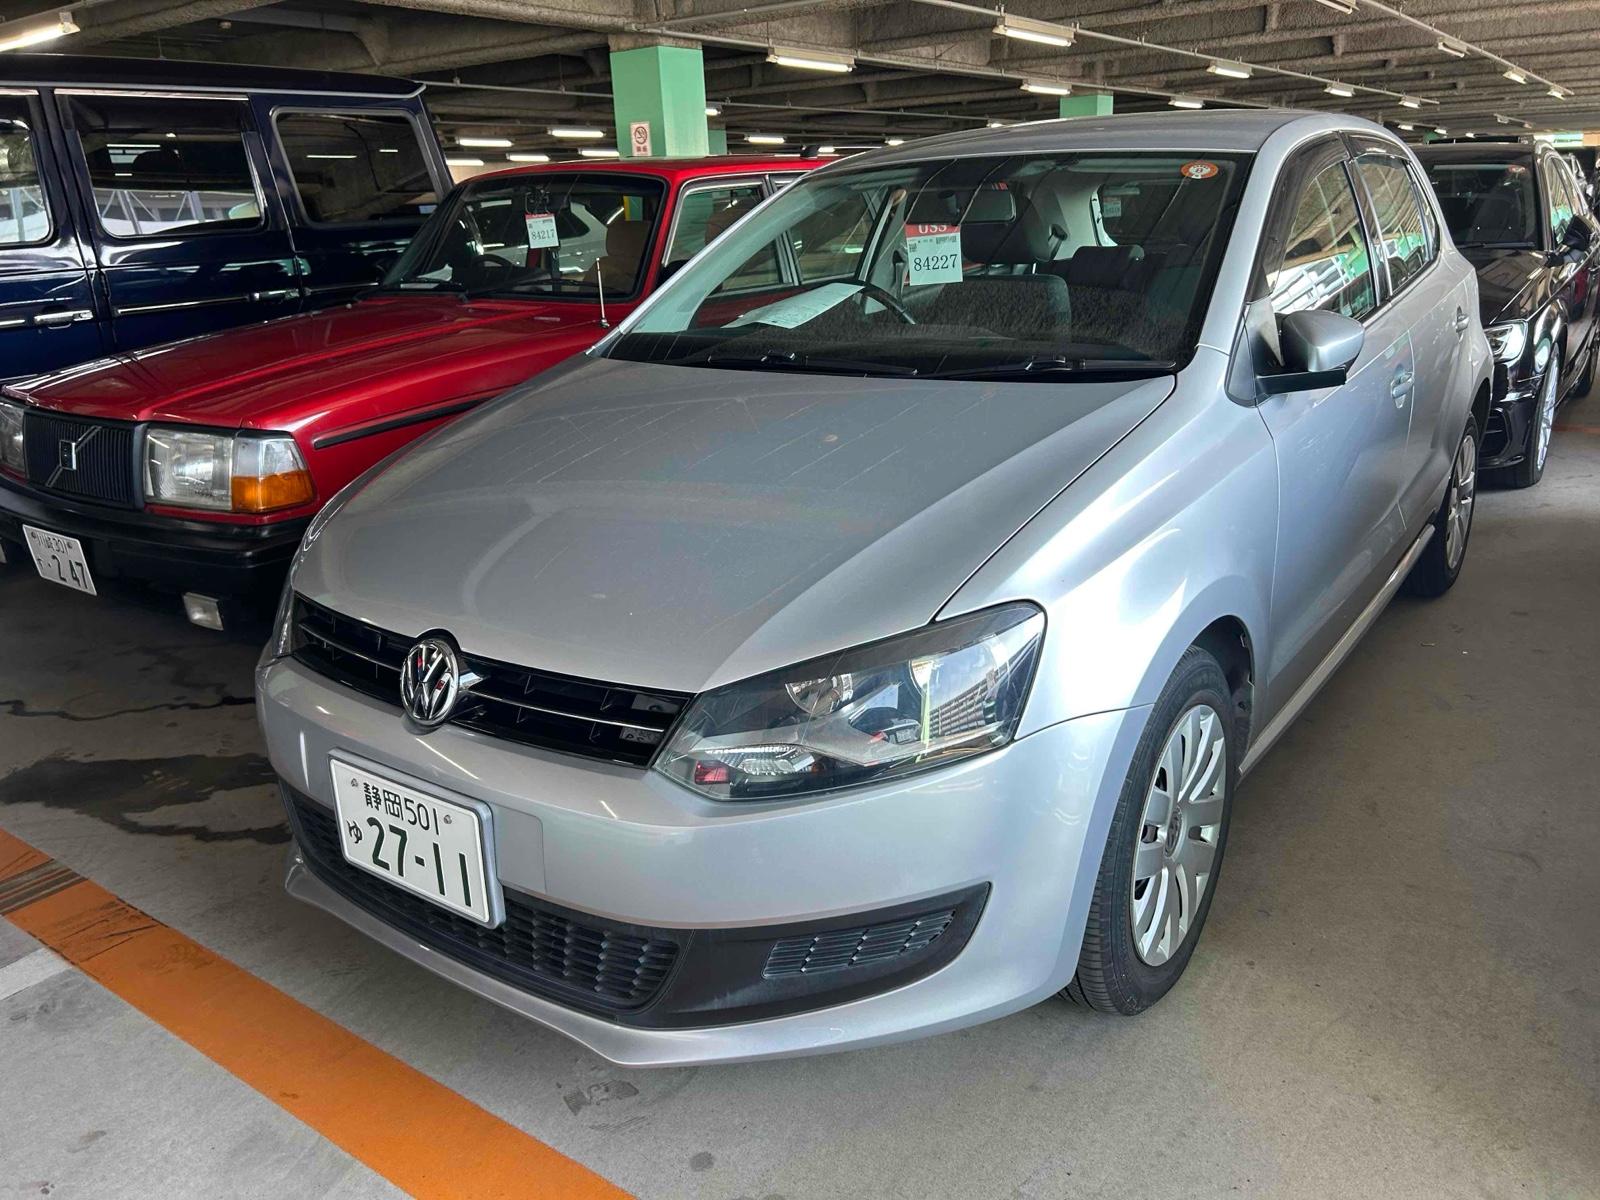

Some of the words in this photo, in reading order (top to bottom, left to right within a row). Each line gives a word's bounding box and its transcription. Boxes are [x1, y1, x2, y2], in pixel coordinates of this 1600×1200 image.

[531, 229, 555, 241] 84217
[913, 253, 958, 272] 84227
[363, 782, 440, 836] 静岡501
[346, 820, 363, 844] ゆ
[366, 816, 472, 908] 27-11
